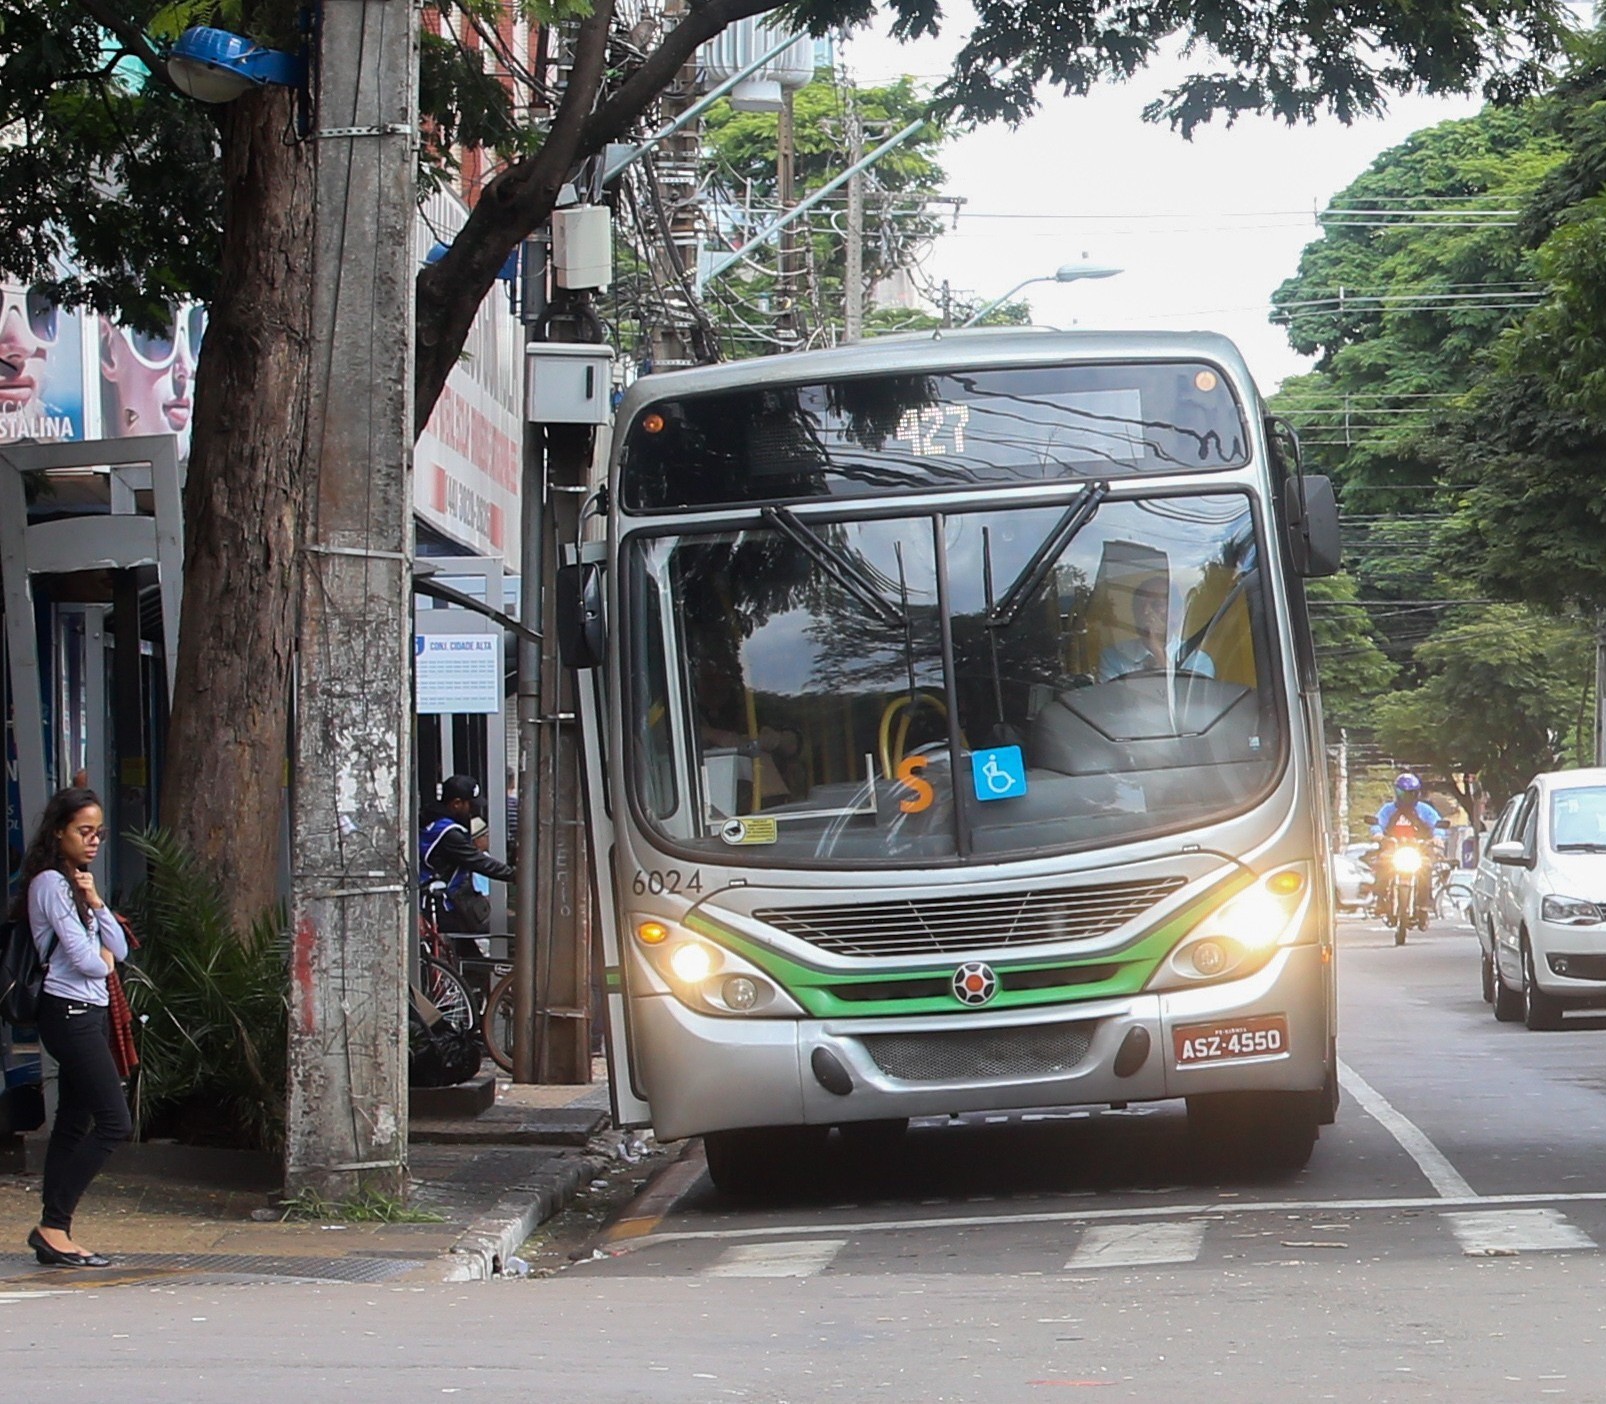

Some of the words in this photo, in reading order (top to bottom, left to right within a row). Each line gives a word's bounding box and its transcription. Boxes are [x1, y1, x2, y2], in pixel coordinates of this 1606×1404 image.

[895, 405, 969, 456] 427
[450, 641, 474, 651] CIDADE
[476, 641, 492, 651] ALTA
[897, 755, 934, 814] S
[632, 868, 703, 896] 6024
[1182, 1029, 1281, 1060] ASZ-4550
